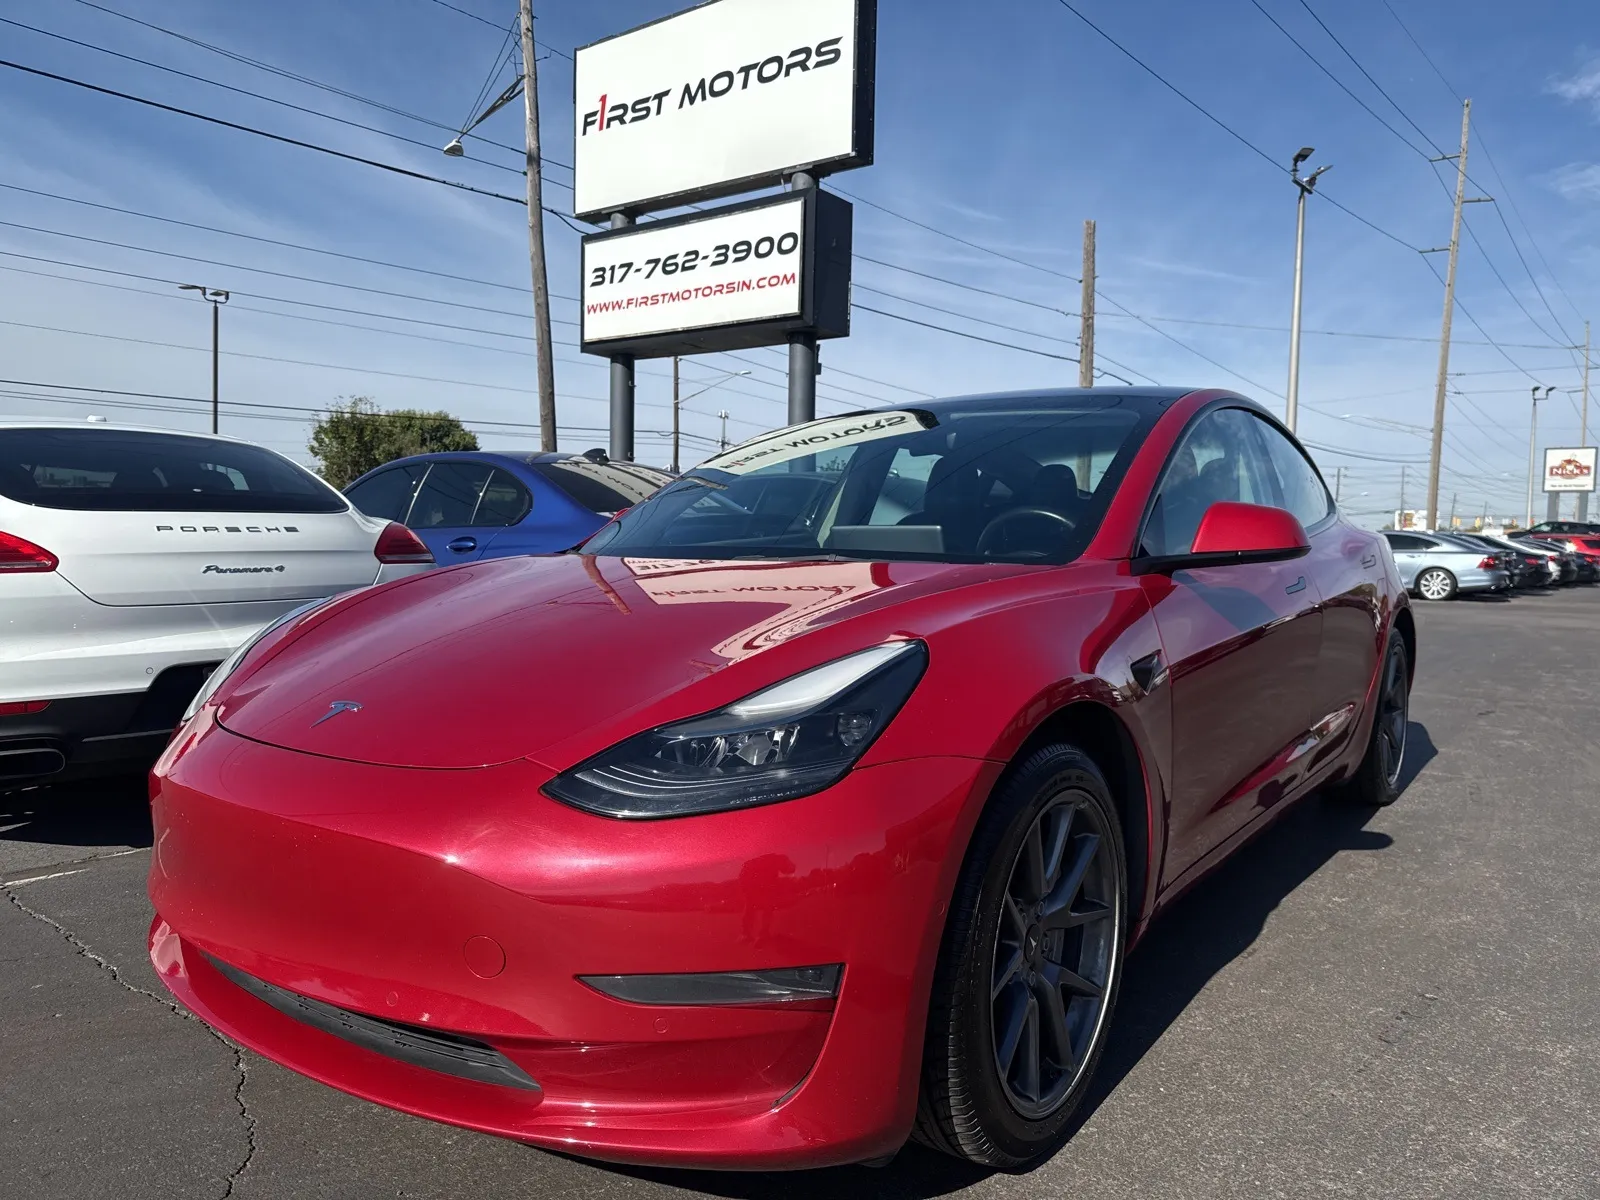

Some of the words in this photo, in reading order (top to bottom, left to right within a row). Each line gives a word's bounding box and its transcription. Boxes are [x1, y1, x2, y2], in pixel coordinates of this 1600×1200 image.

[678, 36, 843, 110] MOTORS
[590, 232, 799, 287] 317-762-3900
[587, 272, 796, 315] WWW.FIRSTMOTORSIN.COM
[155, 525, 300, 533] PORSCHE
[202, 564, 273, 574] Panamera
